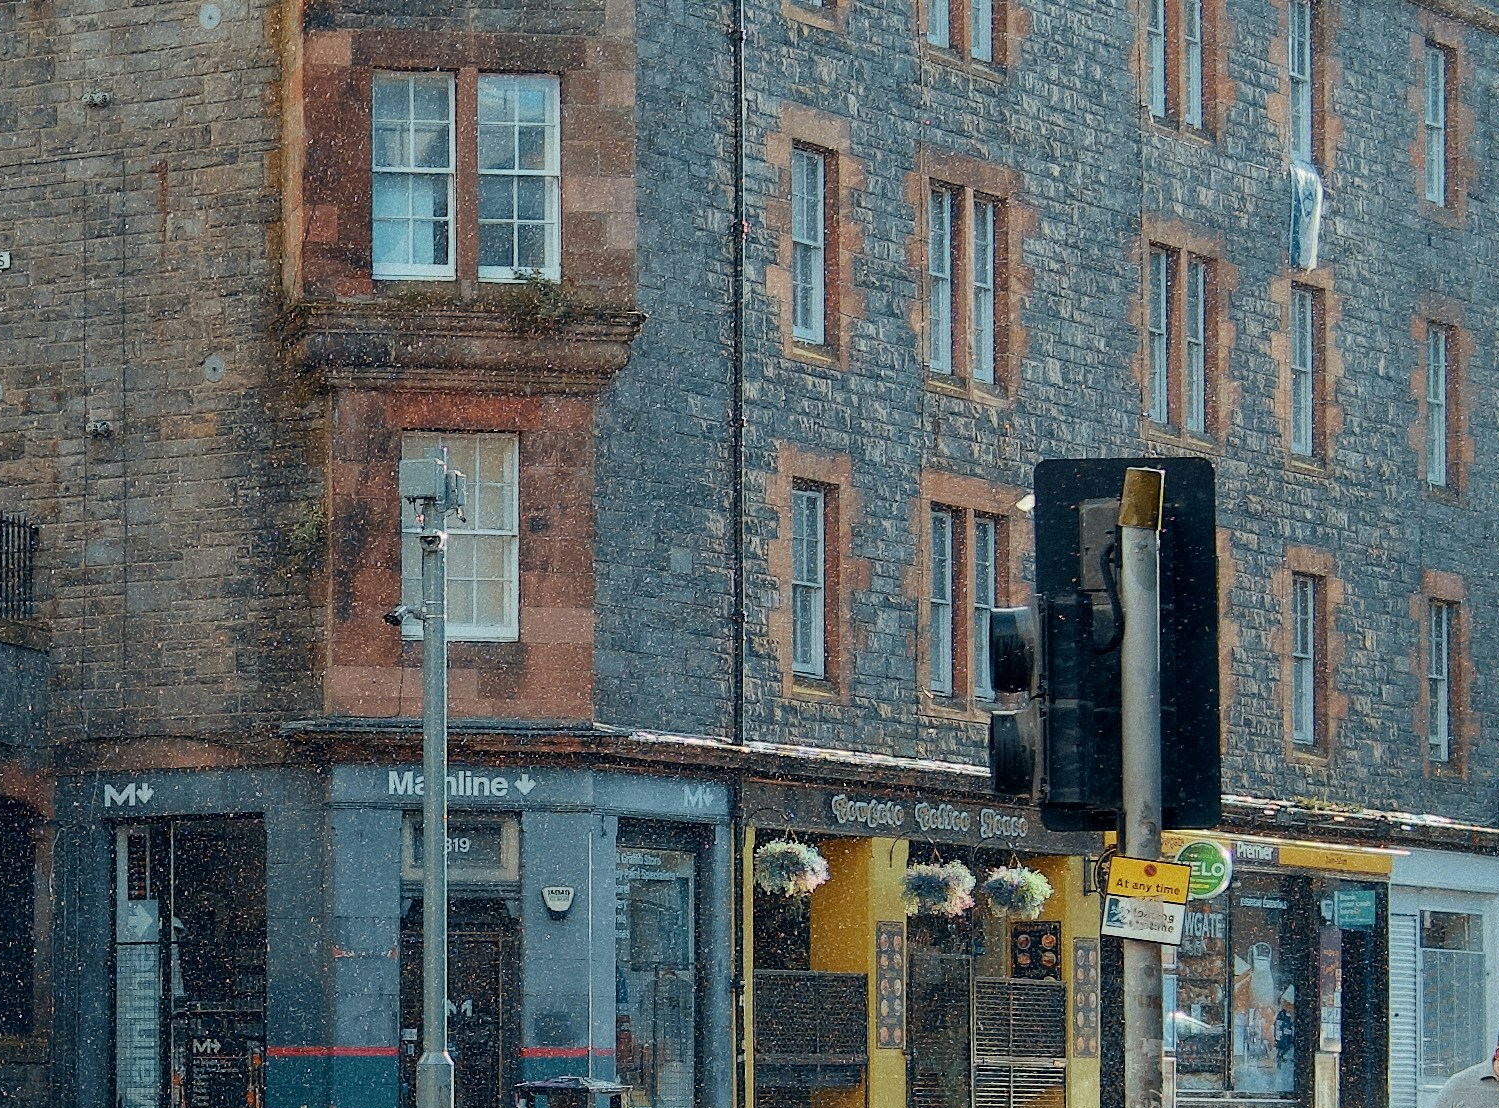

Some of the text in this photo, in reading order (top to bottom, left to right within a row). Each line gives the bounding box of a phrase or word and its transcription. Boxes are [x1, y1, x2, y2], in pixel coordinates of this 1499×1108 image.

[388, 769, 508, 797] Manline
[915, 801, 971, 831] Coffee
[980, 808, 1029, 839] House
[1236, 841, 1275, 860] Premier
[1116, 877, 1128, 889] At
[1131, 881, 1152, 894] any
[1155, 883, 1181, 897] time
[1184, 911, 1226, 938] WGATE
